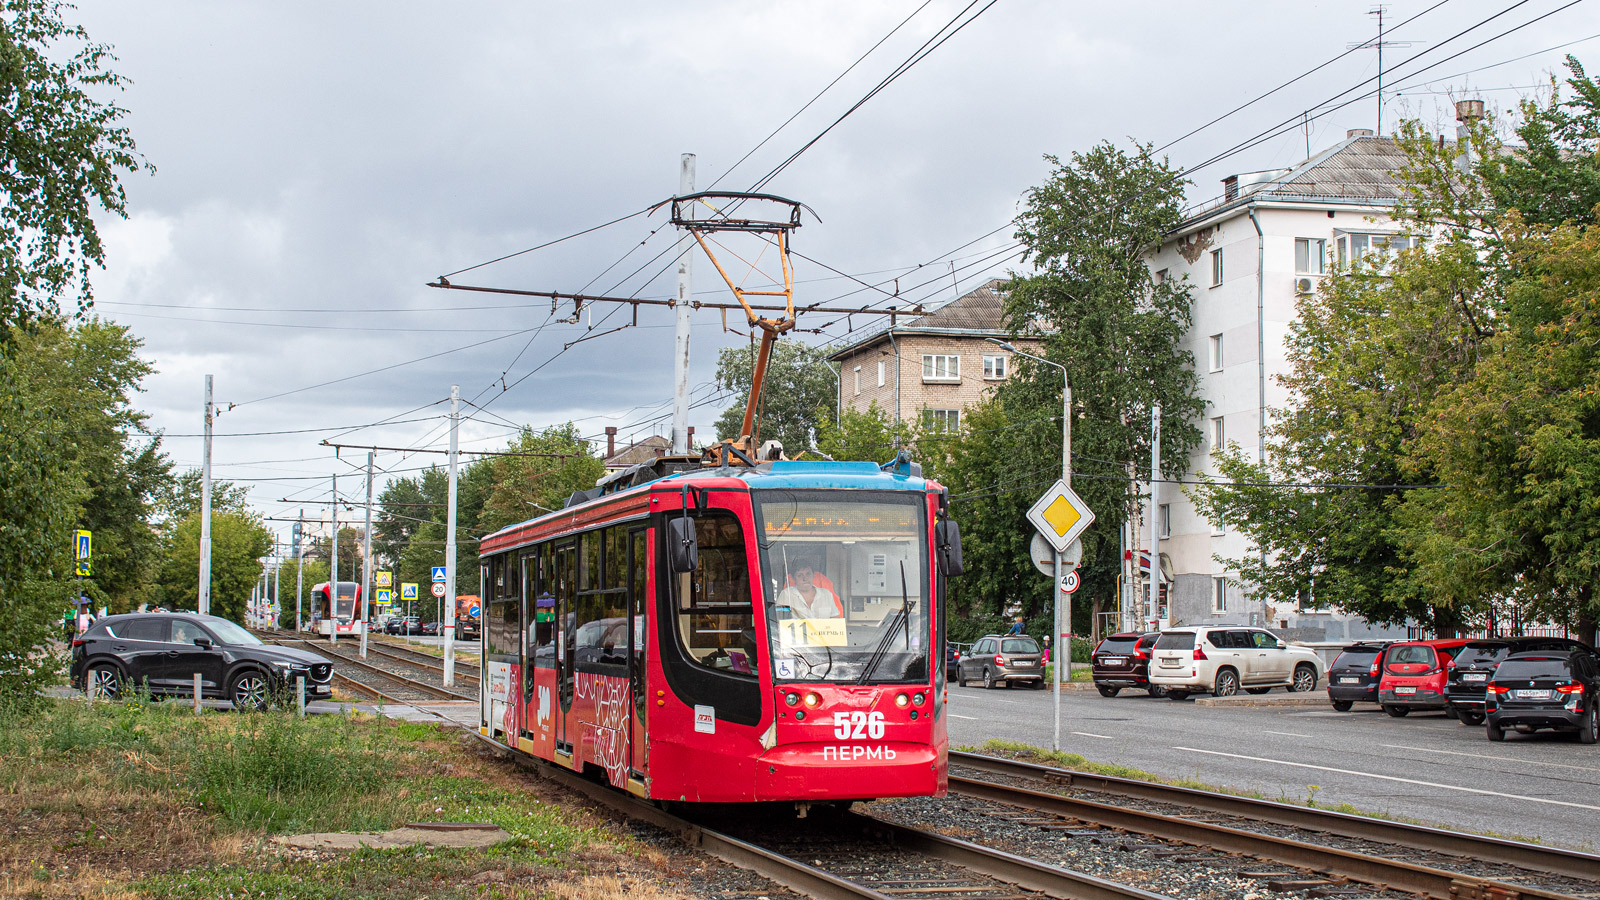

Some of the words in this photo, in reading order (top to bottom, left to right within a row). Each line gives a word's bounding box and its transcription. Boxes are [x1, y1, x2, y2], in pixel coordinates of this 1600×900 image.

[1061, 576, 1075, 586] 40
[788, 622, 808, 645] 11
[834, 711, 885, 740] 526
[823, 745, 897, 761] ПЕРМЬ
